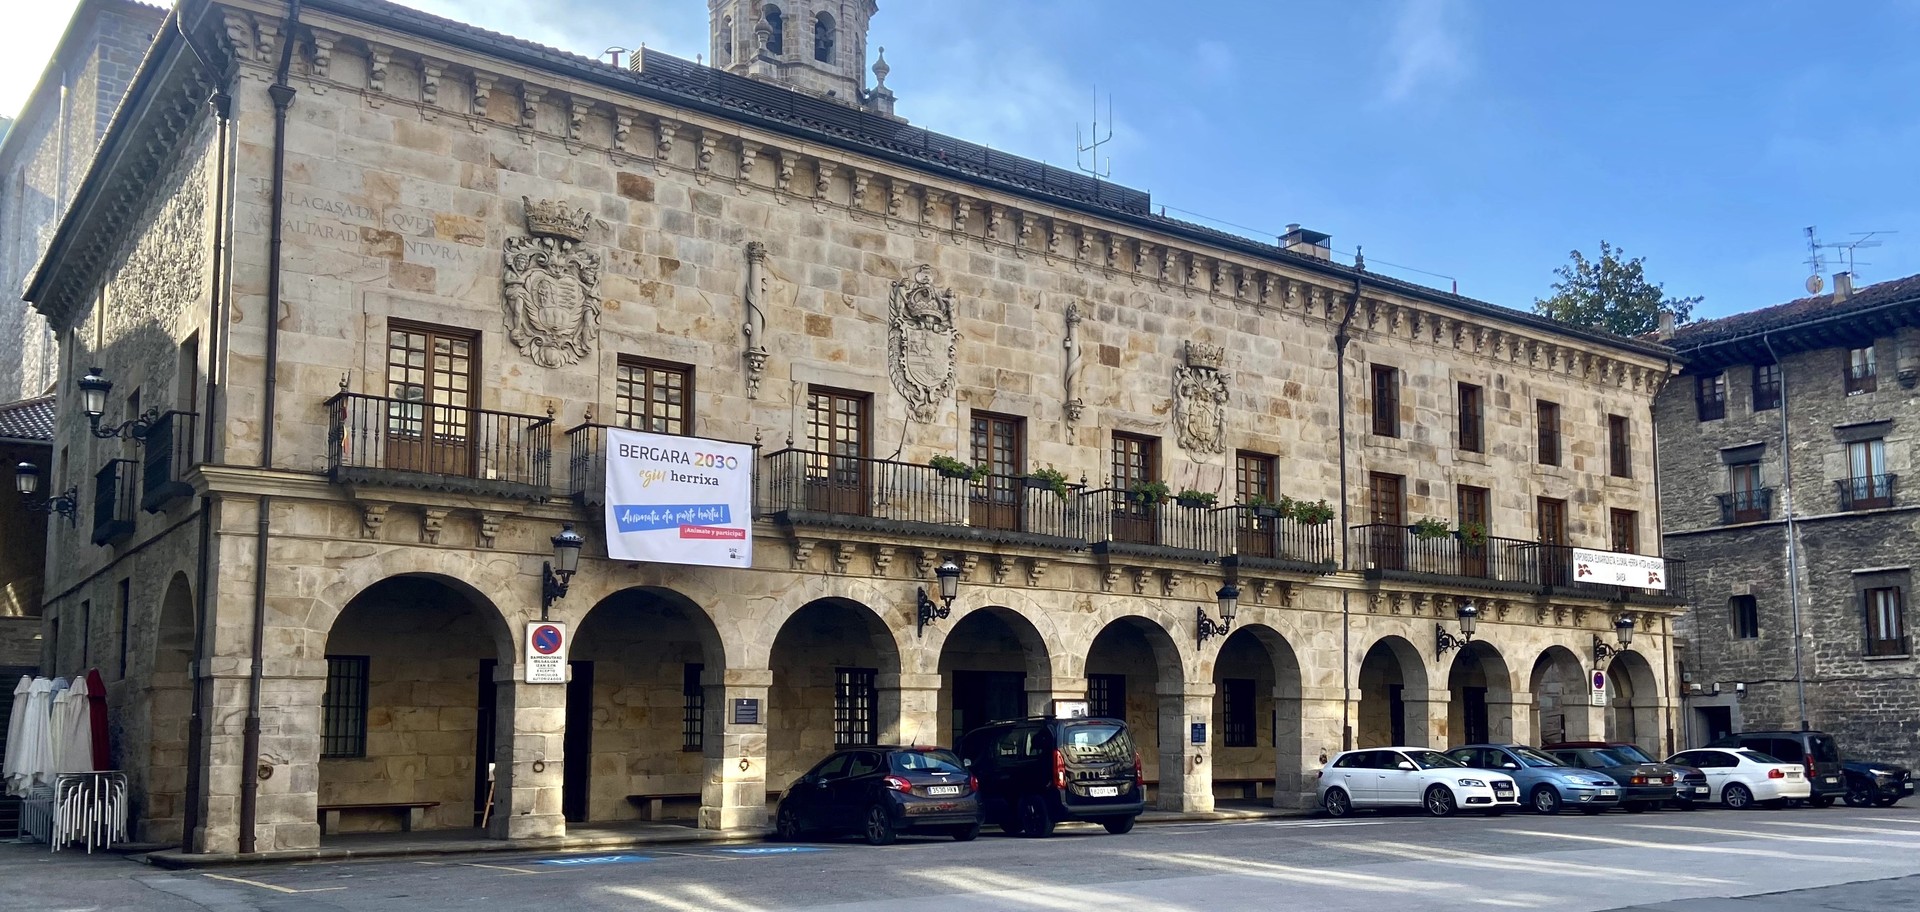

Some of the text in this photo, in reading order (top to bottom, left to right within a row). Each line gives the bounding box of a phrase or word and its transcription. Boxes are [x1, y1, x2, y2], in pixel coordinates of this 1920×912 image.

[619, 443, 738, 470] BERGARA 2030
[670, 470, 719, 486] herrixa
[662, 508, 673, 524] eta
[676, 507, 696, 524] parte
